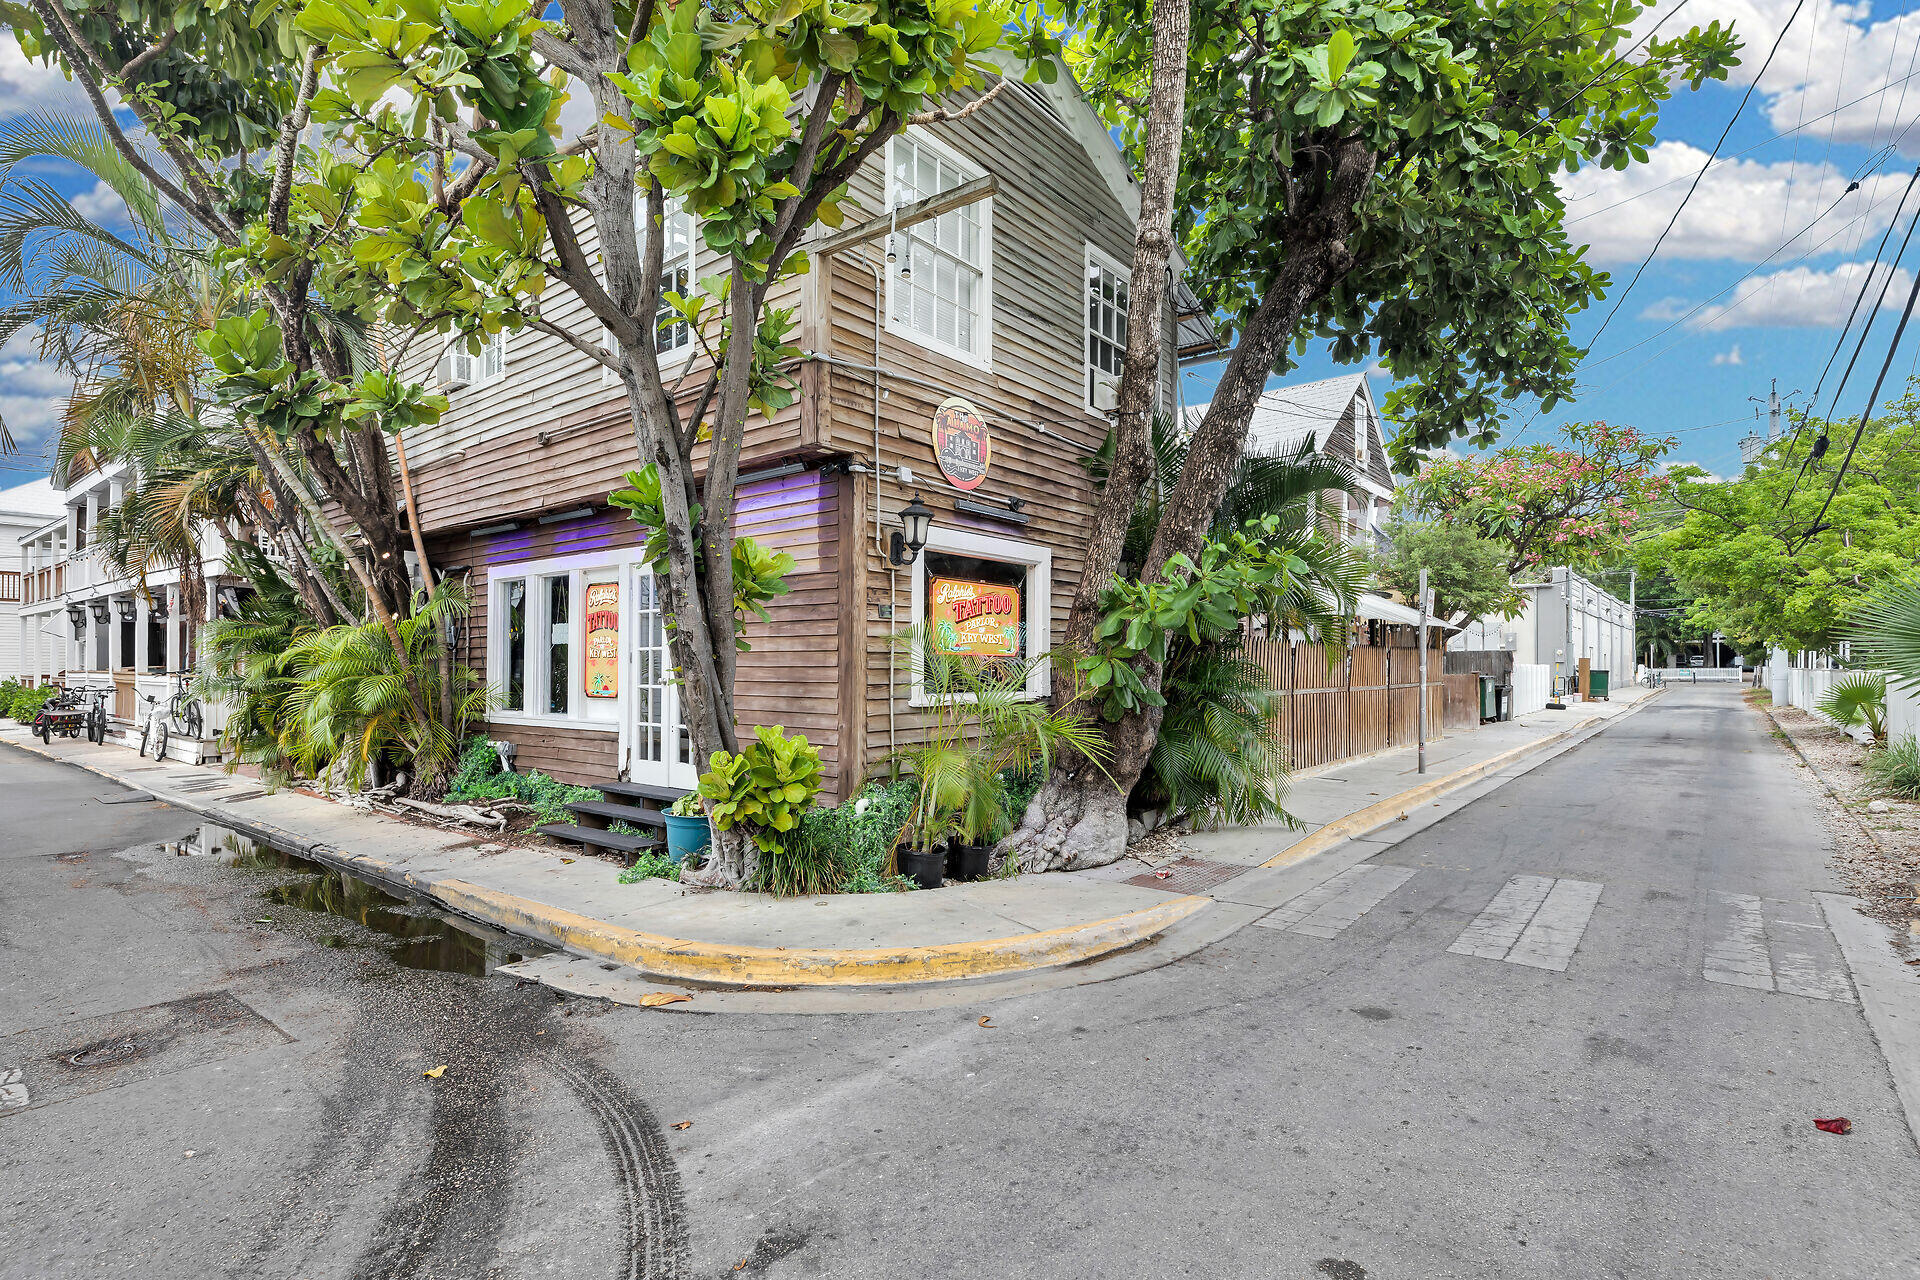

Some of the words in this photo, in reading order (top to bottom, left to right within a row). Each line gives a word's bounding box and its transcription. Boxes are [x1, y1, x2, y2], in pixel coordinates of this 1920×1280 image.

[954, 410, 968, 423] TH
[953, 594, 1012, 624] TATTOO
[588, 611, 618, 633] TATTOO
[965, 617, 998, 632] PARLOR
[960, 632, 978, 644] KEY
[980, 633, 1004, 645] WEST
[589, 647, 601, 658] KEY
[601, 648, 617, 658] WEST
